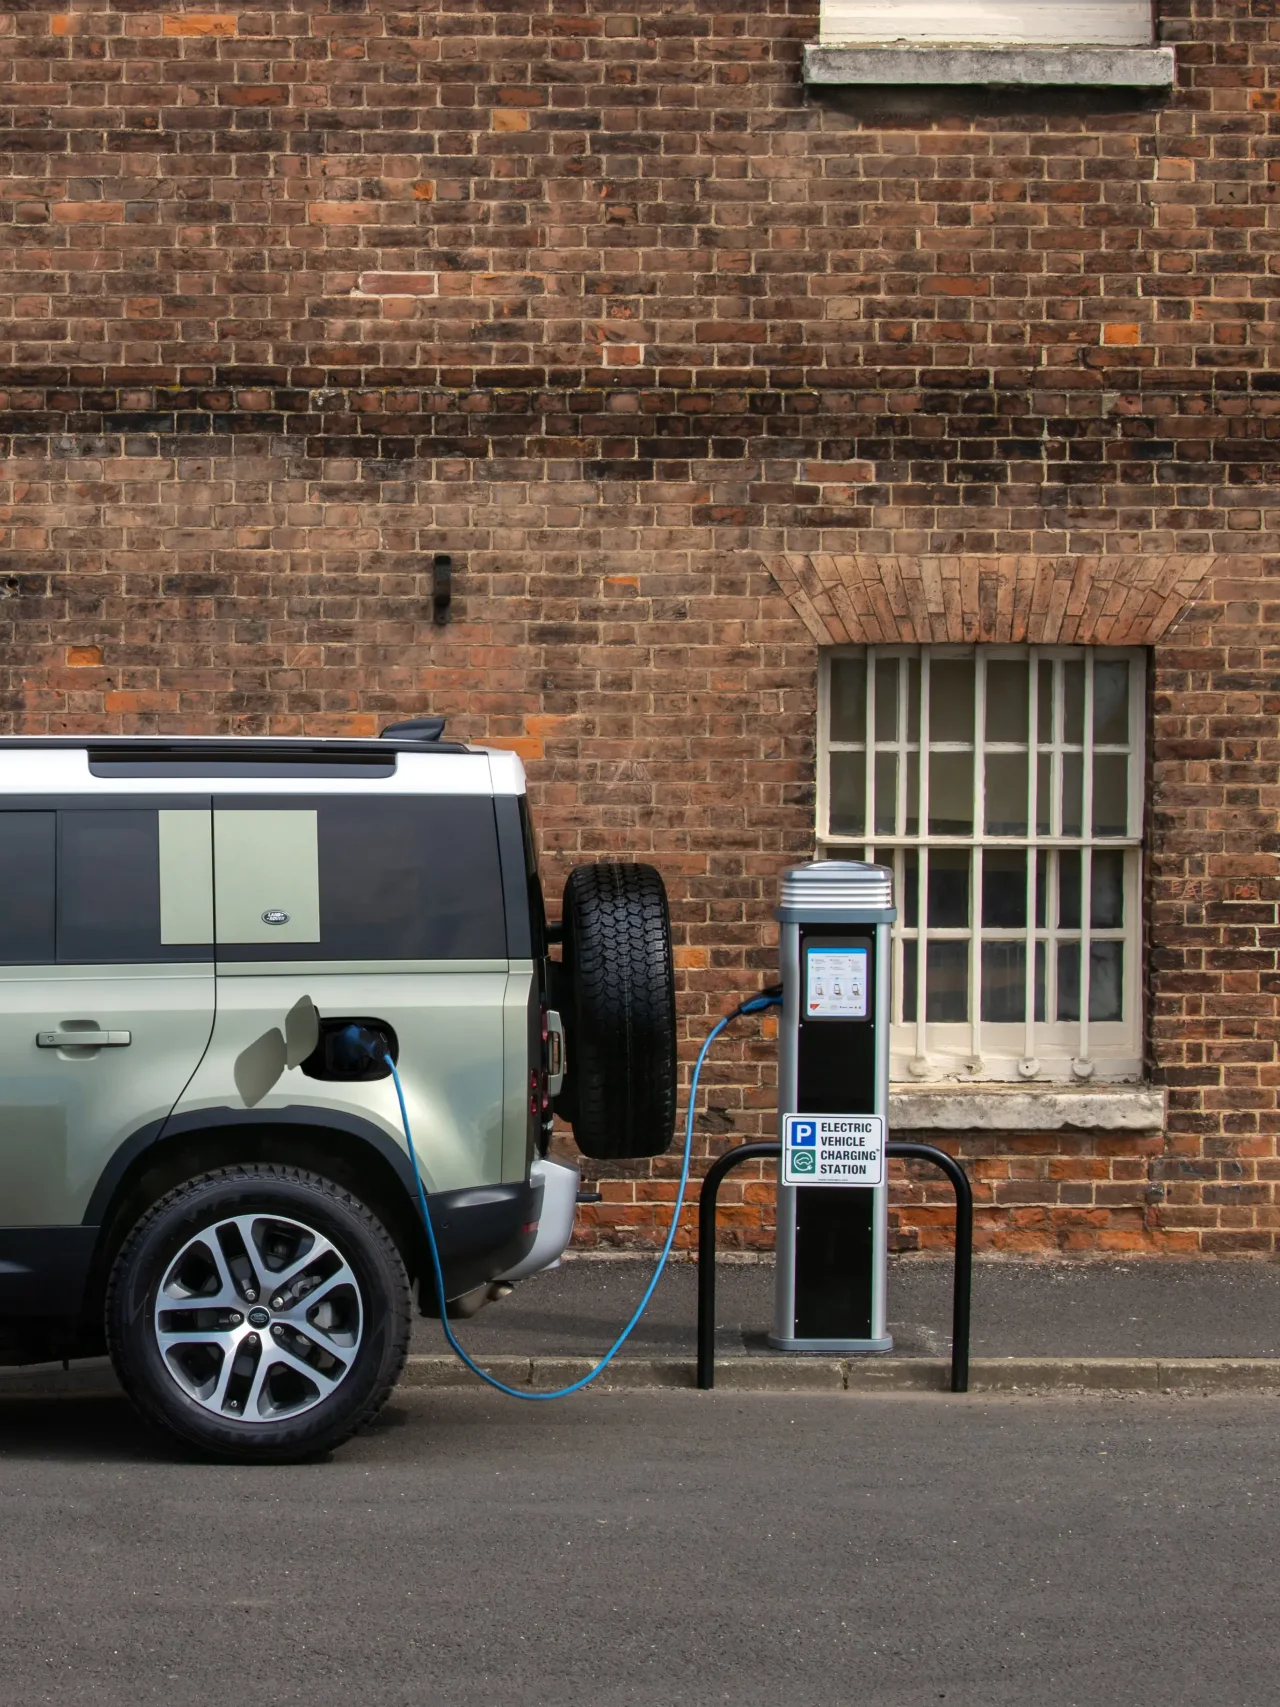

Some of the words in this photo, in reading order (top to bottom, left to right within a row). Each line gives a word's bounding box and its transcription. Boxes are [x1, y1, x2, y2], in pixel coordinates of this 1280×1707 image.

[821, 1122, 872, 1133] ELECTRIC
[796, 1124, 812, 1143] P
[820, 1136, 866, 1147] VEHICLE
[820, 1150, 877, 1161] CHARGING
[820, 1164, 867, 1174] STATION
